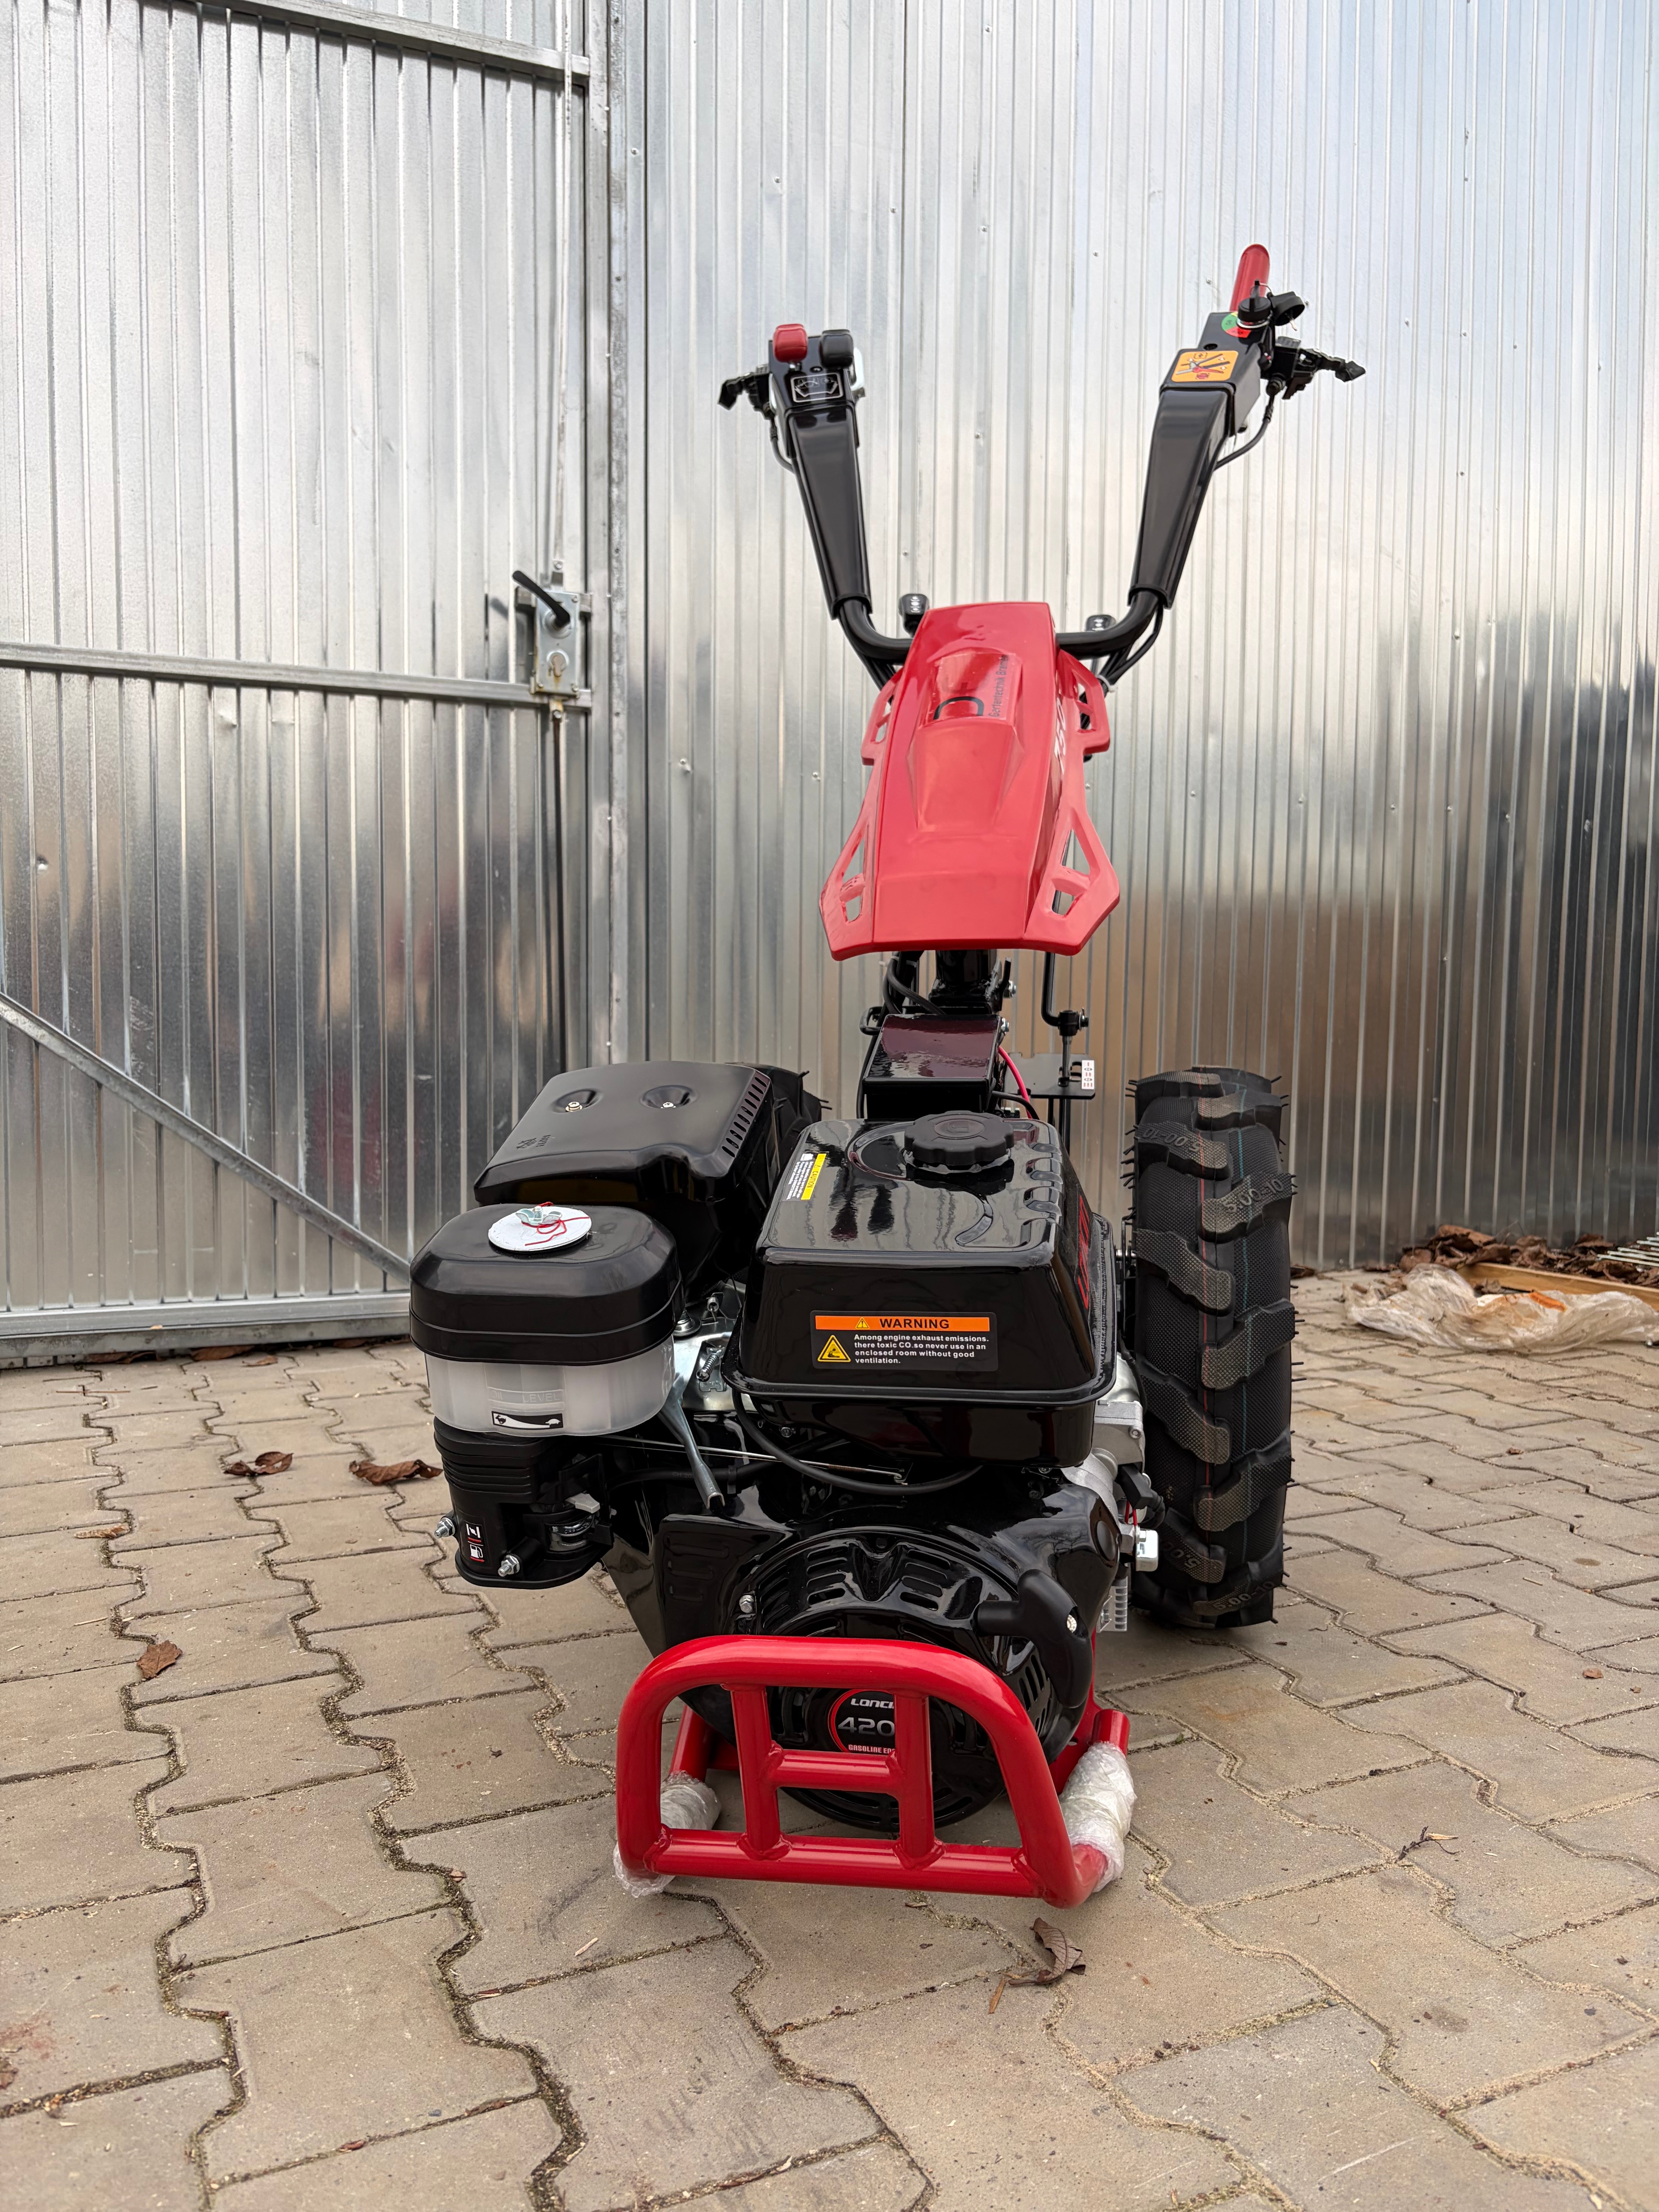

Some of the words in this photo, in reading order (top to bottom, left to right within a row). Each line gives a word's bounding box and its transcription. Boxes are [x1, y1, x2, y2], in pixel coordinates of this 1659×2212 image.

[995, 654, 1009, 675] Bremen
[988, 677, 1005, 717] Gartentechnik
[1142, 1127, 1200, 1152] 5.00-10
[807, 1171, 819, 1188] CAUTION
[1221, 1179, 1284, 1214] 5.00-10
[879, 1319, 950, 1329] WARNING
[491, 1390, 503, 1400] OIL
[522, 1393, 561, 1403] LEVEL
[1212, 1581, 1275, 1610] 5.00-10
[850, 1698, 894, 1709] LONCI
[837, 1716, 895, 1737] 420
[848, 1744, 882, 1753] GASOLINE
